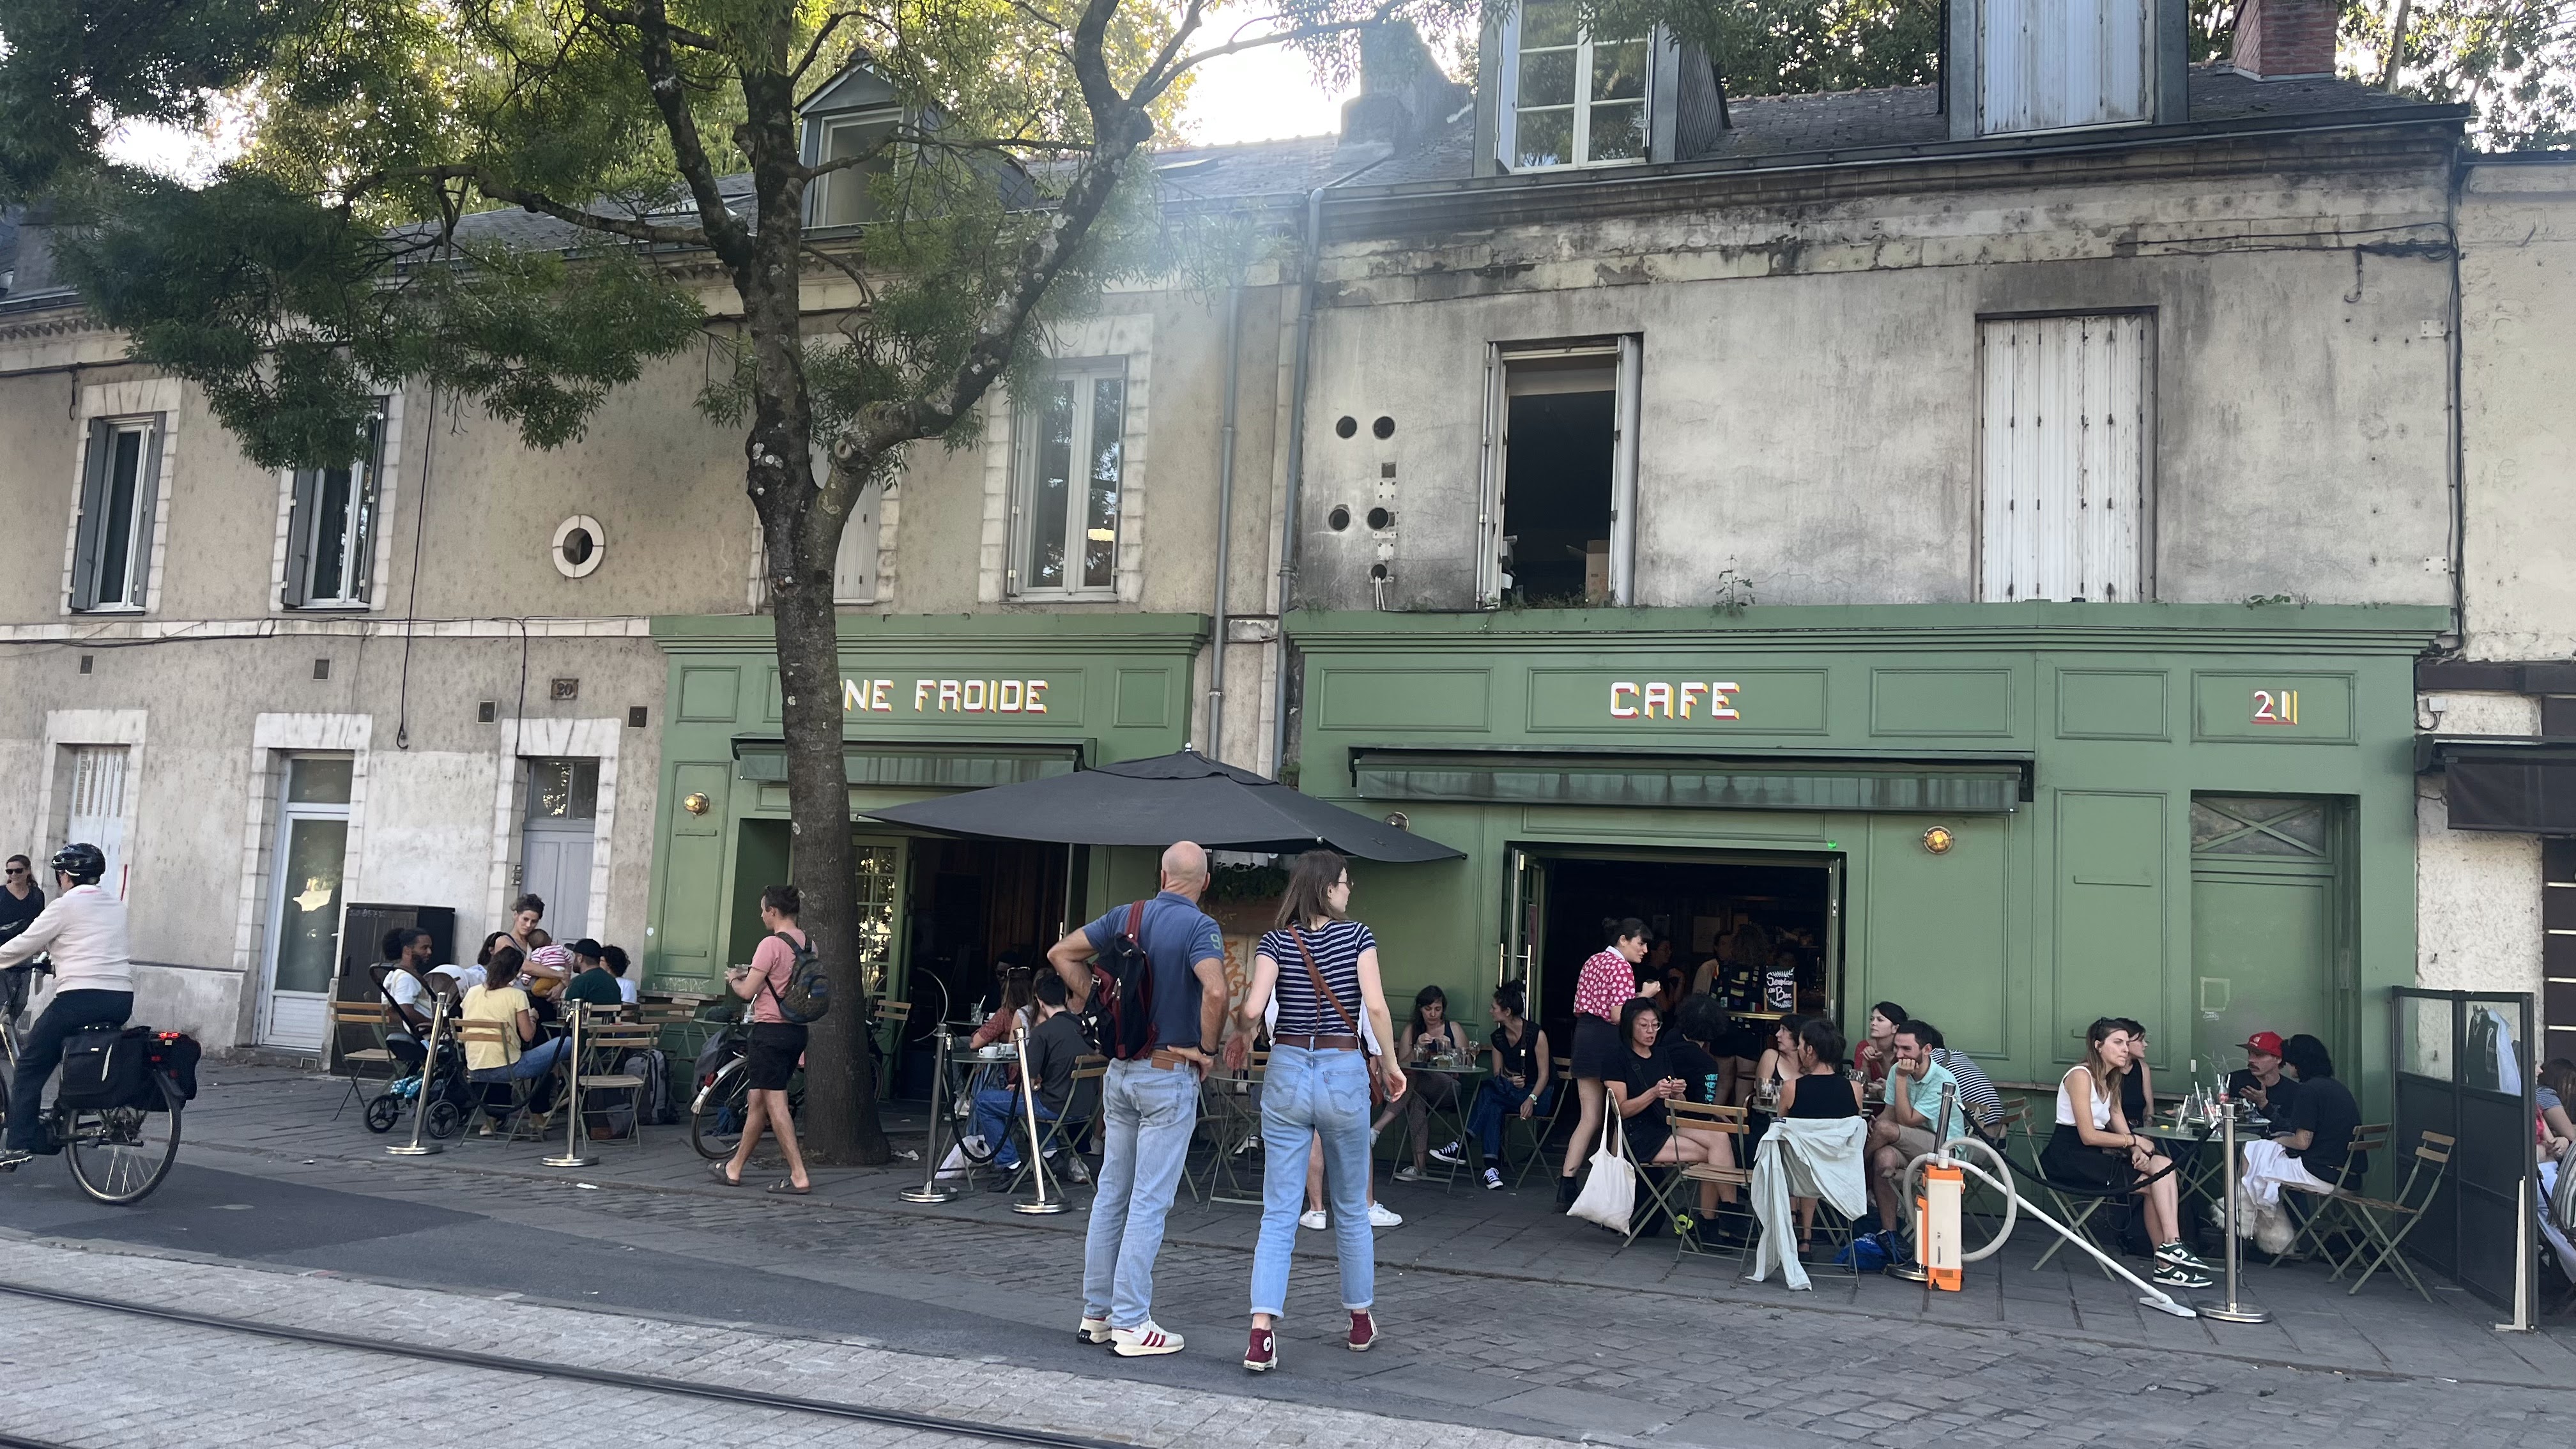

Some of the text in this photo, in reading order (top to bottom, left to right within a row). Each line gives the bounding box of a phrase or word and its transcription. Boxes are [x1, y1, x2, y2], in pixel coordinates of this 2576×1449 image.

[557, 683, 573, 695] 20
[840, 679, 1048, 714] NE FROIDE
[1610, 682, 1740, 720] CAFE
[2254, 691, 2290, 721] 21
[1210, 933, 1222, 950] 9
